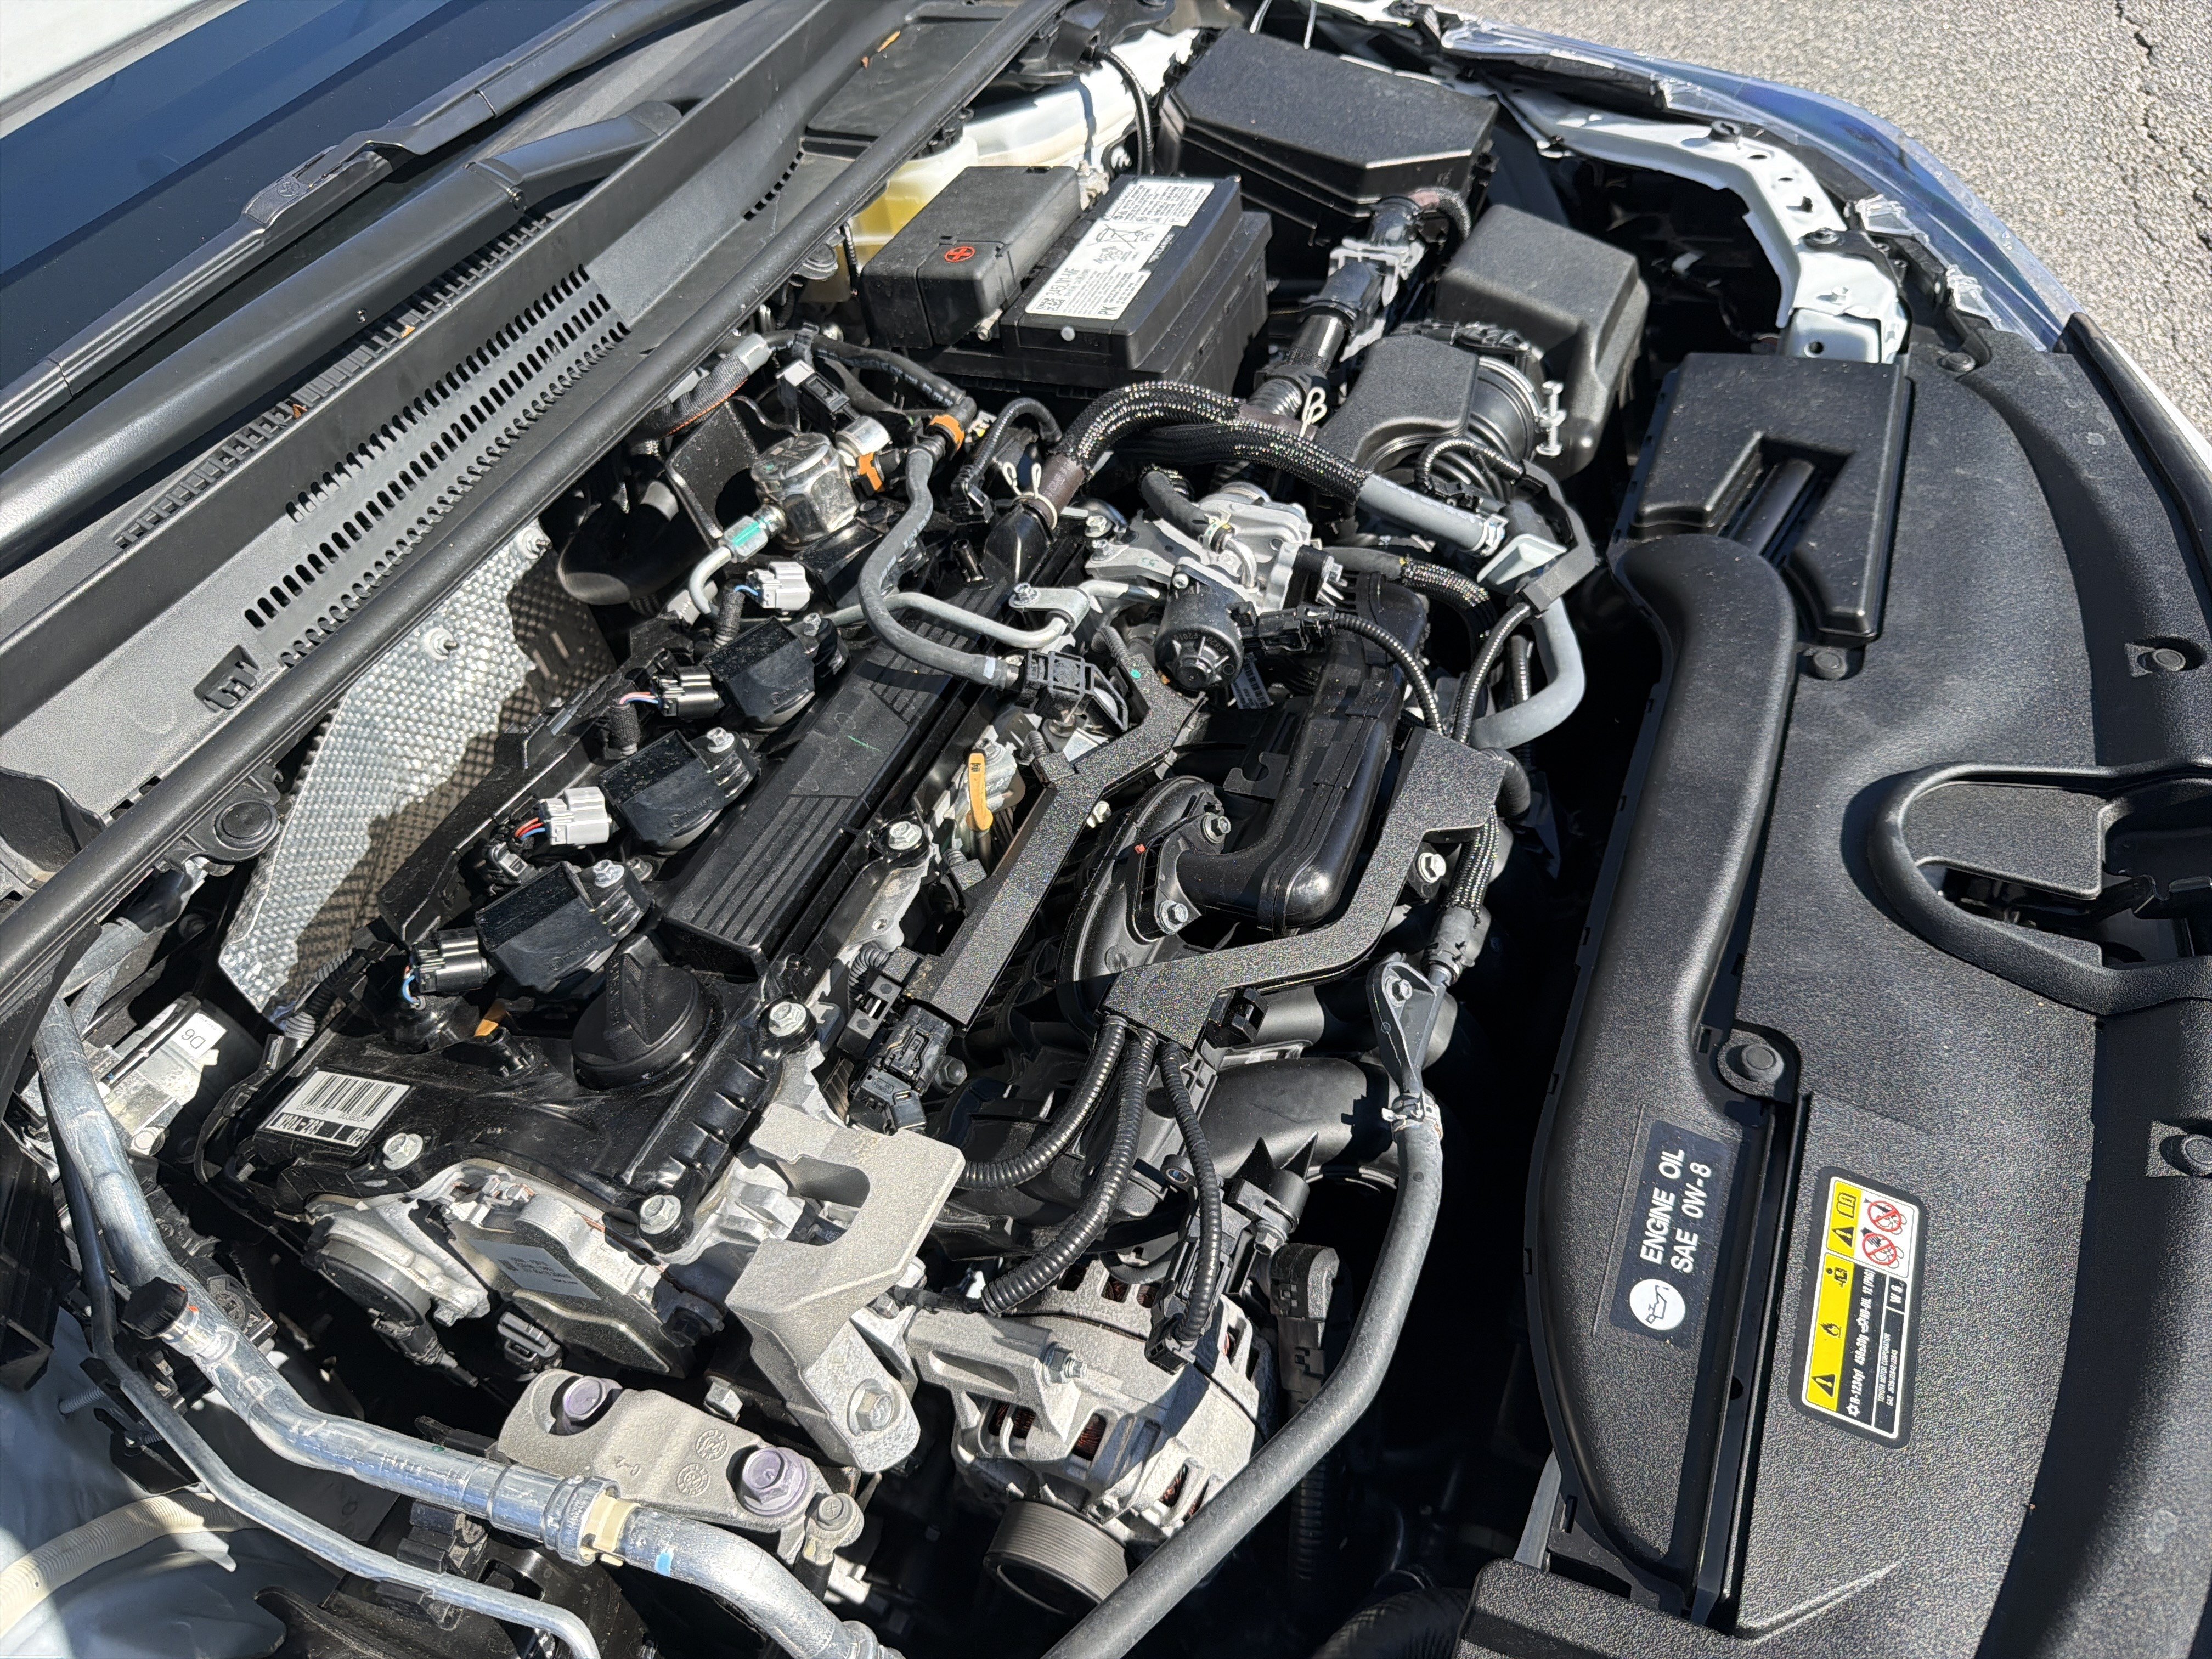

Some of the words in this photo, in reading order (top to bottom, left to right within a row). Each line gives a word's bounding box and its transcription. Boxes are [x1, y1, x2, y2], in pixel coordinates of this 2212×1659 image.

[181, 1029, 206, 1049] D6
[1681, 1161, 1712, 1218] 0W-8
[1640, 1187, 1676, 1265] ENGINE
[1658, 1149, 1685, 1180] OIL
[1671, 1227, 1699, 1273] SAE
[1863, 1268, 1876, 1286] (PAG)
[1859, 1298, 1872, 1319] ND-OIL
[1881, 1333, 1891, 1365] CORPORATION
[1850, 1368, 1865, 1405] R-1234yf
[1880, 1366, 1888, 1383] MOTOR
